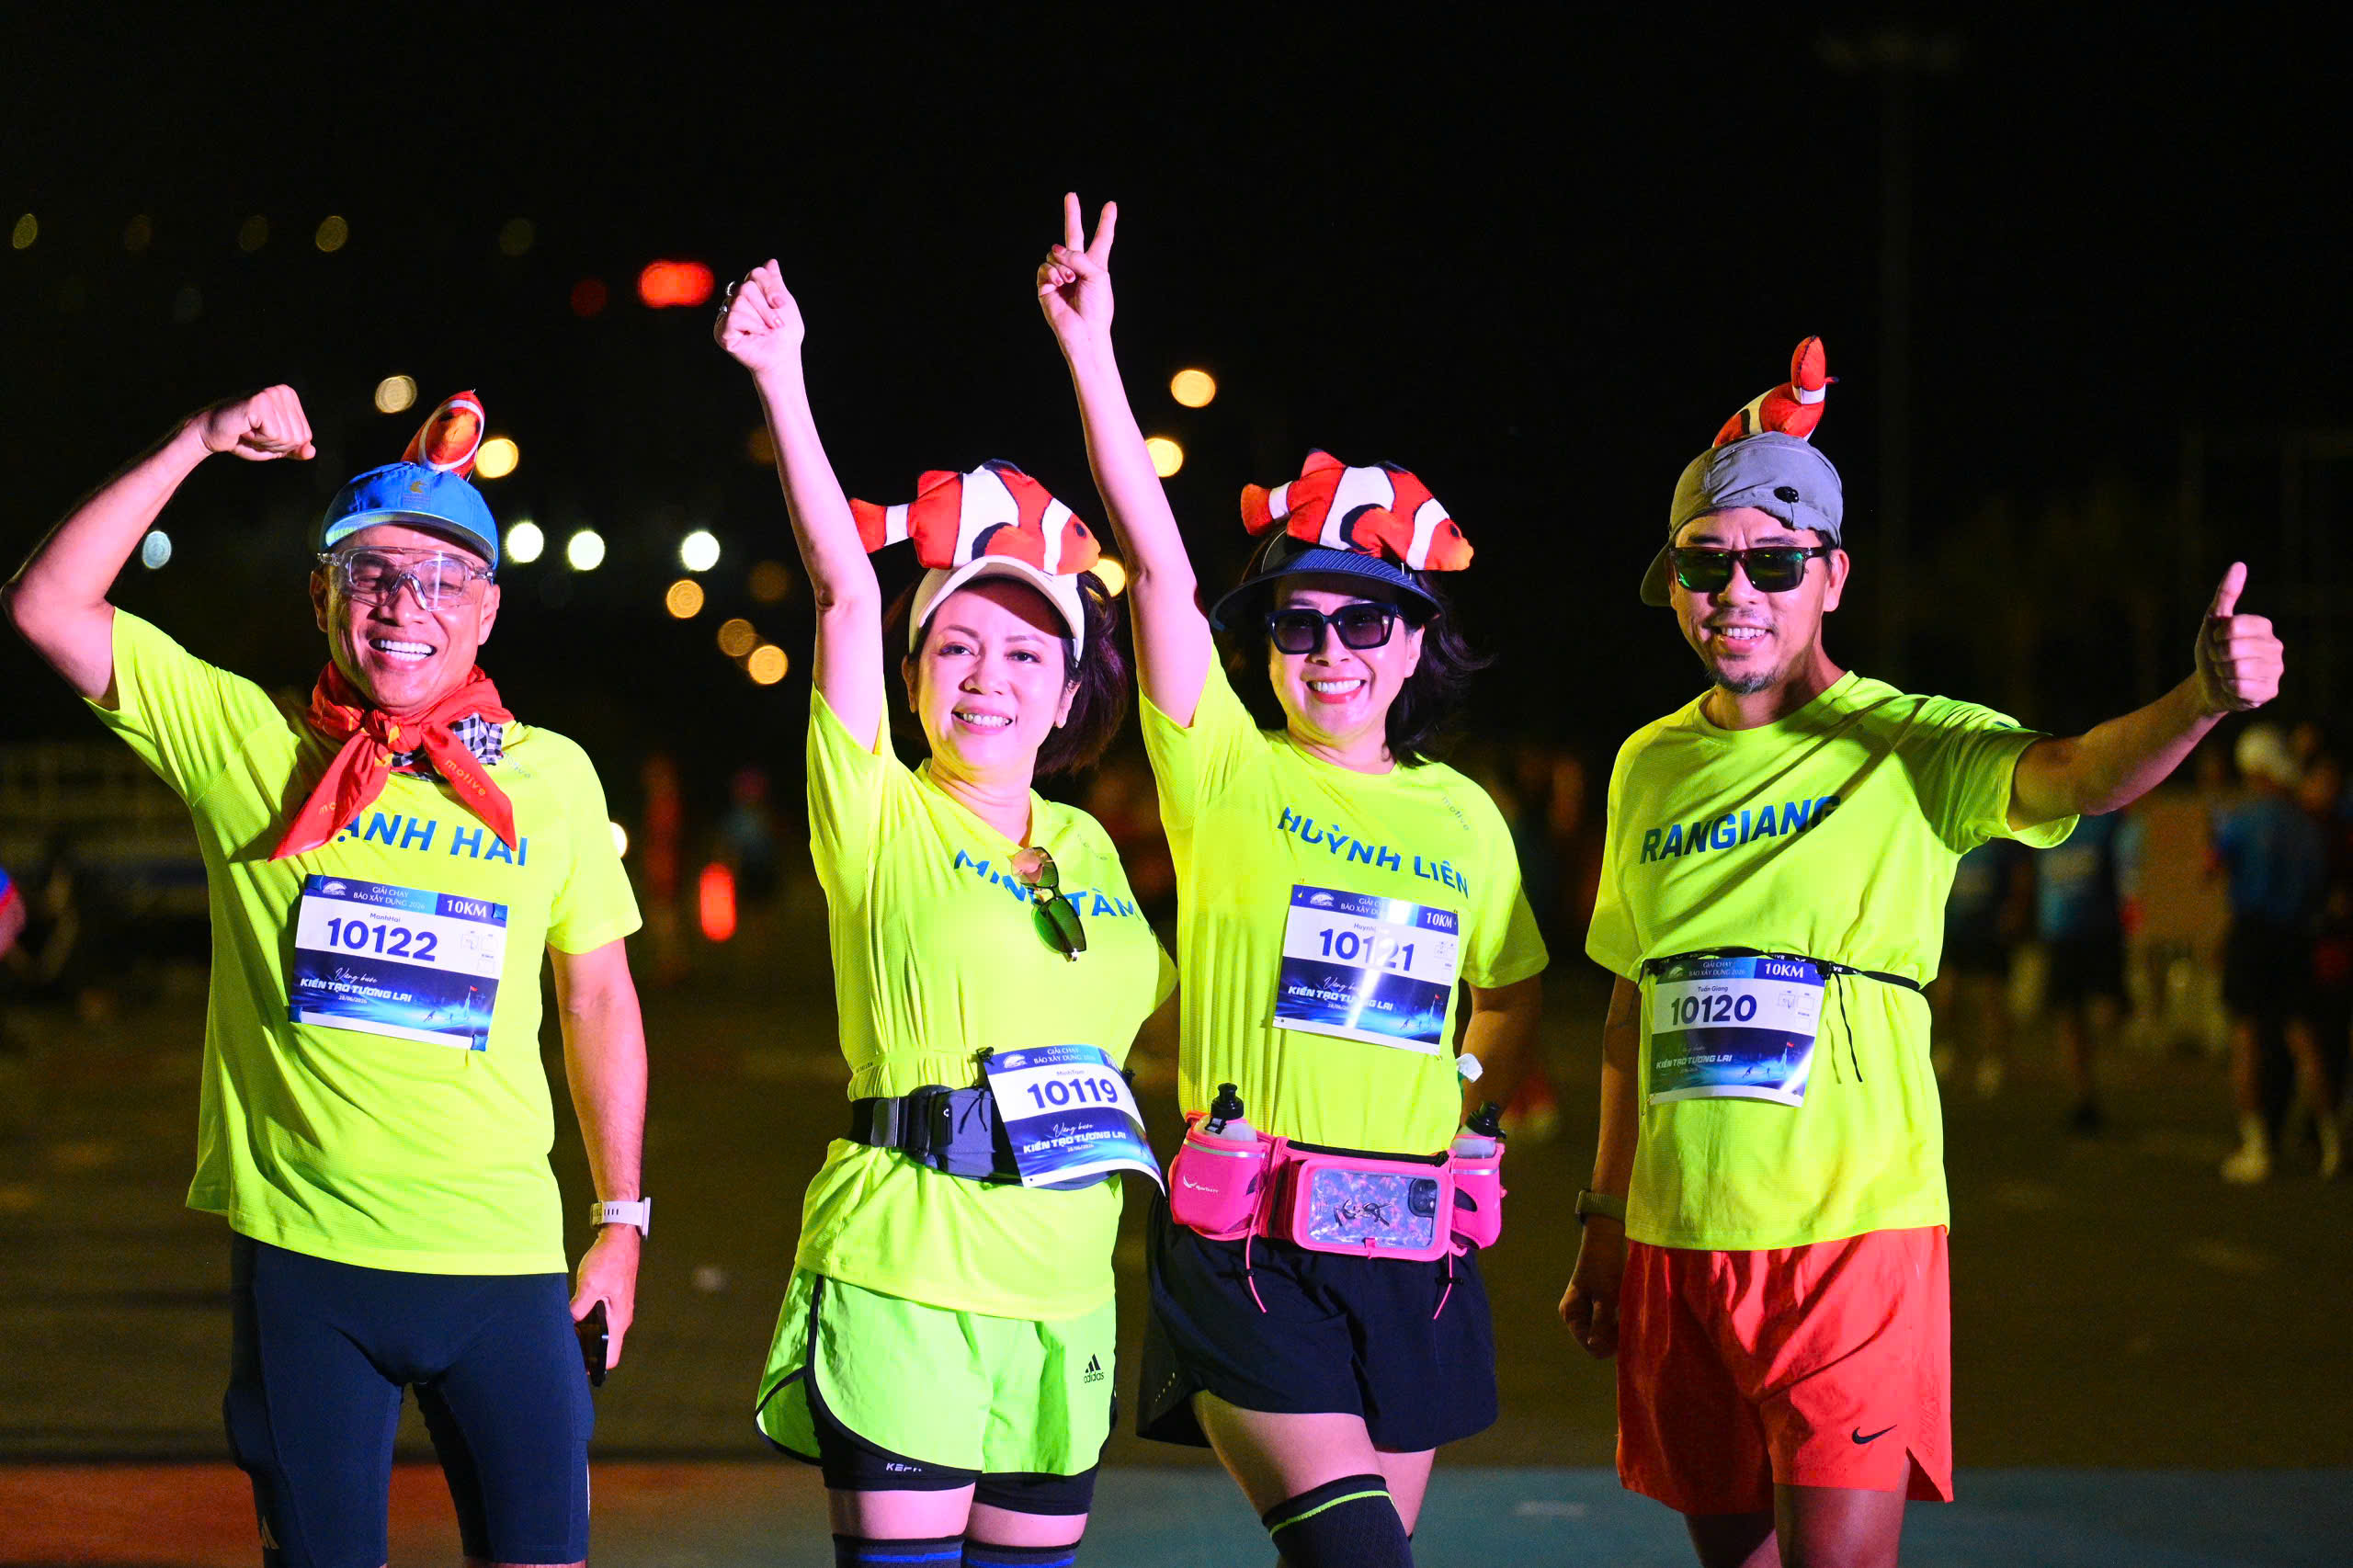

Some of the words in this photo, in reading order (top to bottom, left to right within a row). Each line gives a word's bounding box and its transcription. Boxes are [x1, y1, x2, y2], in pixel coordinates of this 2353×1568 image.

[445, 759, 486, 797] motive
[1640, 796, 1841, 865] RANGIANG
[1277, 806, 1402, 872] HUỲNH
[1413, 856, 1469, 899] LIÊN
[353, 891, 368, 901] BÁO
[369, 893, 384, 903] XÂY
[447, 899, 487, 918] 10KM
[1426, 912, 1452, 928] 10KM
[327, 917, 438, 962] 10122
[1319, 928, 1415, 971] 10121
[1765, 962, 1804, 979] 10KM
[300, 977, 326, 990] KIẾN
[392, 992, 413, 1003] LAI
[1288, 985, 1315, 997] KIẾN
[1377, 1001, 1394, 1011] LAI
[1671, 994, 1757, 1026] 10120
[1716, 1054, 1733, 1062] LAI
[1027, 1077, 1119, 1109] 10119
[1023, 1141, 1051, 1154] KIẾN
[1110, 1131, 1127, 1140] LAI
[1083, 1371, 1105, 1384] adidas
